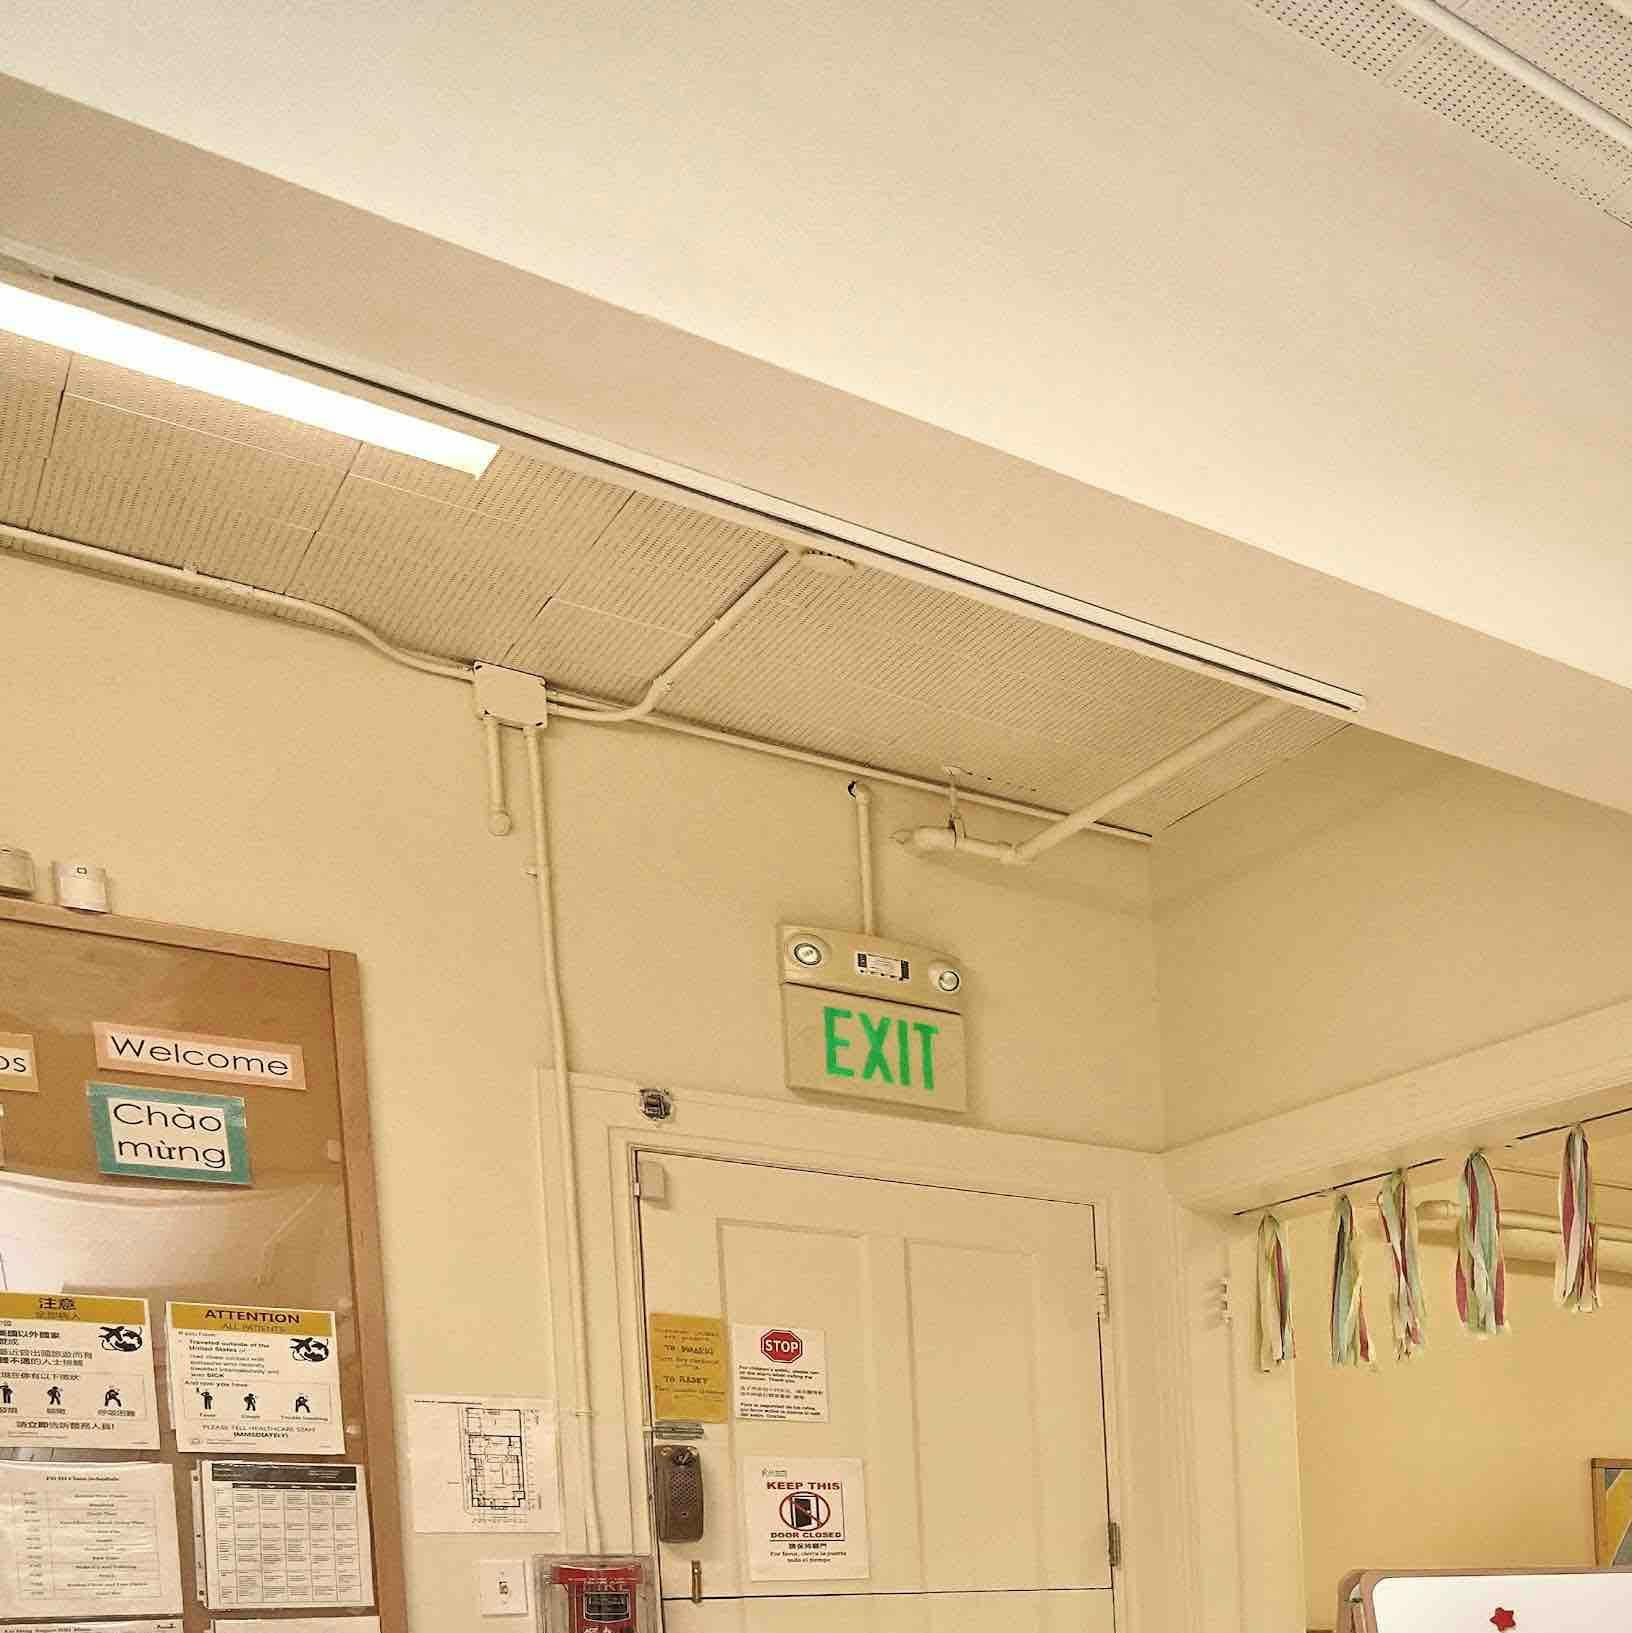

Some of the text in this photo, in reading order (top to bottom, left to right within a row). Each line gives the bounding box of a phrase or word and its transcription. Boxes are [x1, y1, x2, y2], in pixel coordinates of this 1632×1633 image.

[111, 1035, 289, 1076] Welcome
[824, 1006, 940, 1091] EXIT
[113, 1103, 222, 1133] Chào
[118, 1138, 227, 1169] mừng
[205, 1309, 300, 1324] ATTENTION
[765, 1339, 799, 1353] STOP
[766, 1482, 841, 1490] KEEP THIS
